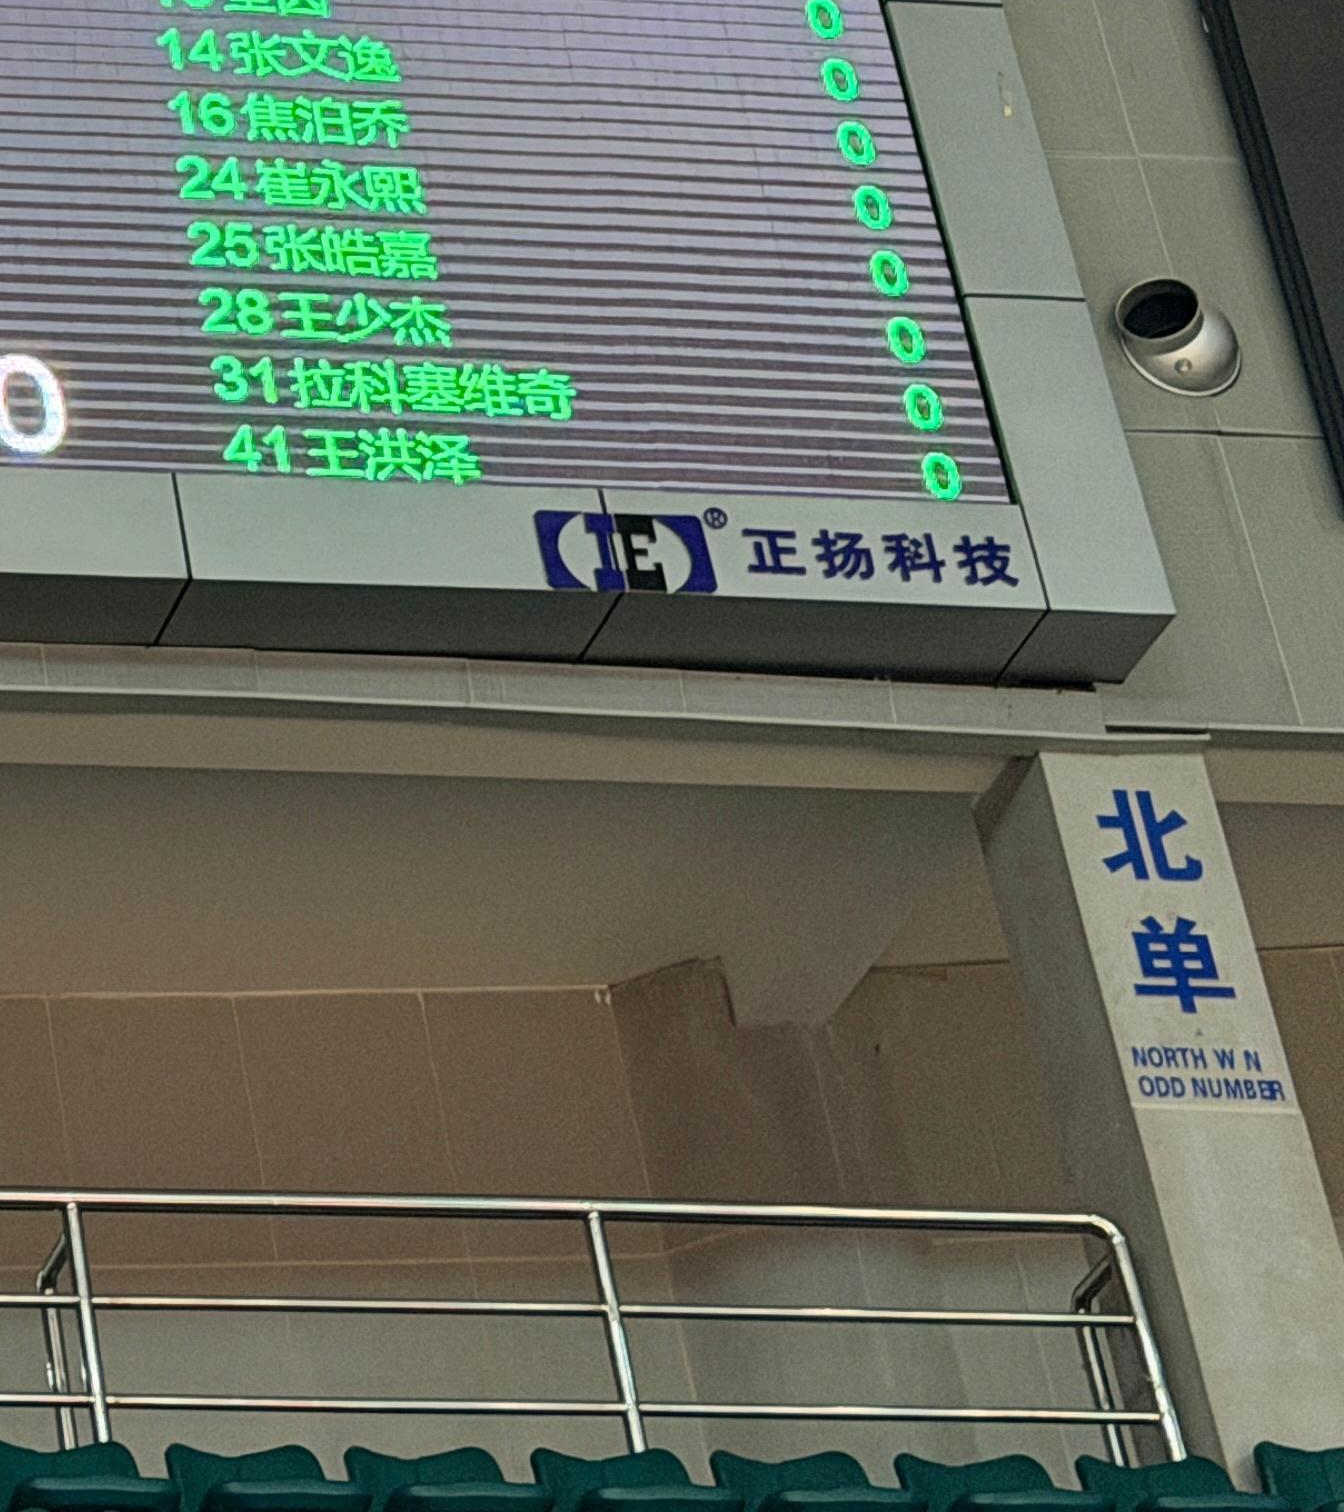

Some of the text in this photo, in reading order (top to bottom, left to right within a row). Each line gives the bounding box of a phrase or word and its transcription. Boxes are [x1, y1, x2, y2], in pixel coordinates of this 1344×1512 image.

[819, 55, 861, 104] 0
[836, 120, 879, 168] 0
[852, 184, 895, 233] 0
[867, 248, 912, 297] 0
[885, 316, 927, 367] 0
[902, 383, 945, 432] 0
[921, 451, 964, 503] 0
[741, 527, 1020, 587] 正扬科技
[1130, 1045, 1209, 1070] NORTH
[1138, 1074, 1186, 1099] ODD
